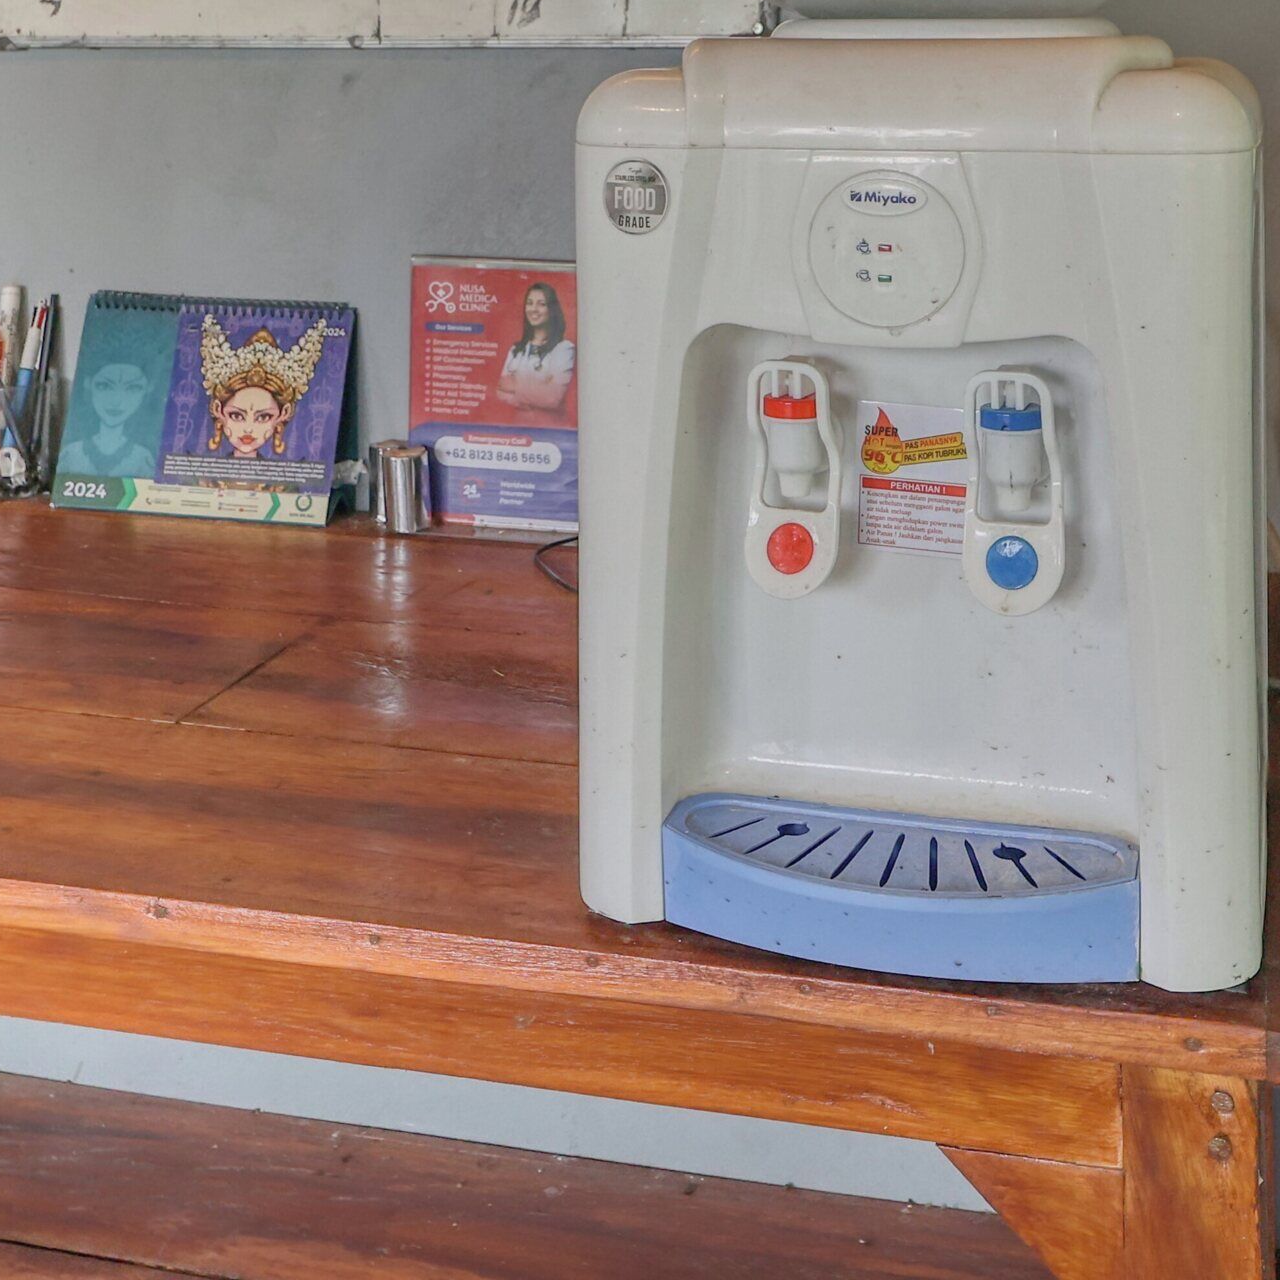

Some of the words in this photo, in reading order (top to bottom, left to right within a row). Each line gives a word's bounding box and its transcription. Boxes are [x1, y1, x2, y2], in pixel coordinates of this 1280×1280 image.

[614, 186, 656, 211] FOOD
[864, 191, 917, 206] Miyako
[618, 214, 651, 229] GRADE
[459, 284, 486, 293] NUSA
[459, 294, 498, 303] MEDICA
[459, 303, 490, 312] CLINIC
[864, 424, 899, 437] SUPER
[864, 435, 885, 446] HOT
[446, 448, 467, 459] +62
[468, 449, 493, 461] 8123
[62, 480, 107, 499] 2024
[890, 481, 940, 494] PERHATIAN
